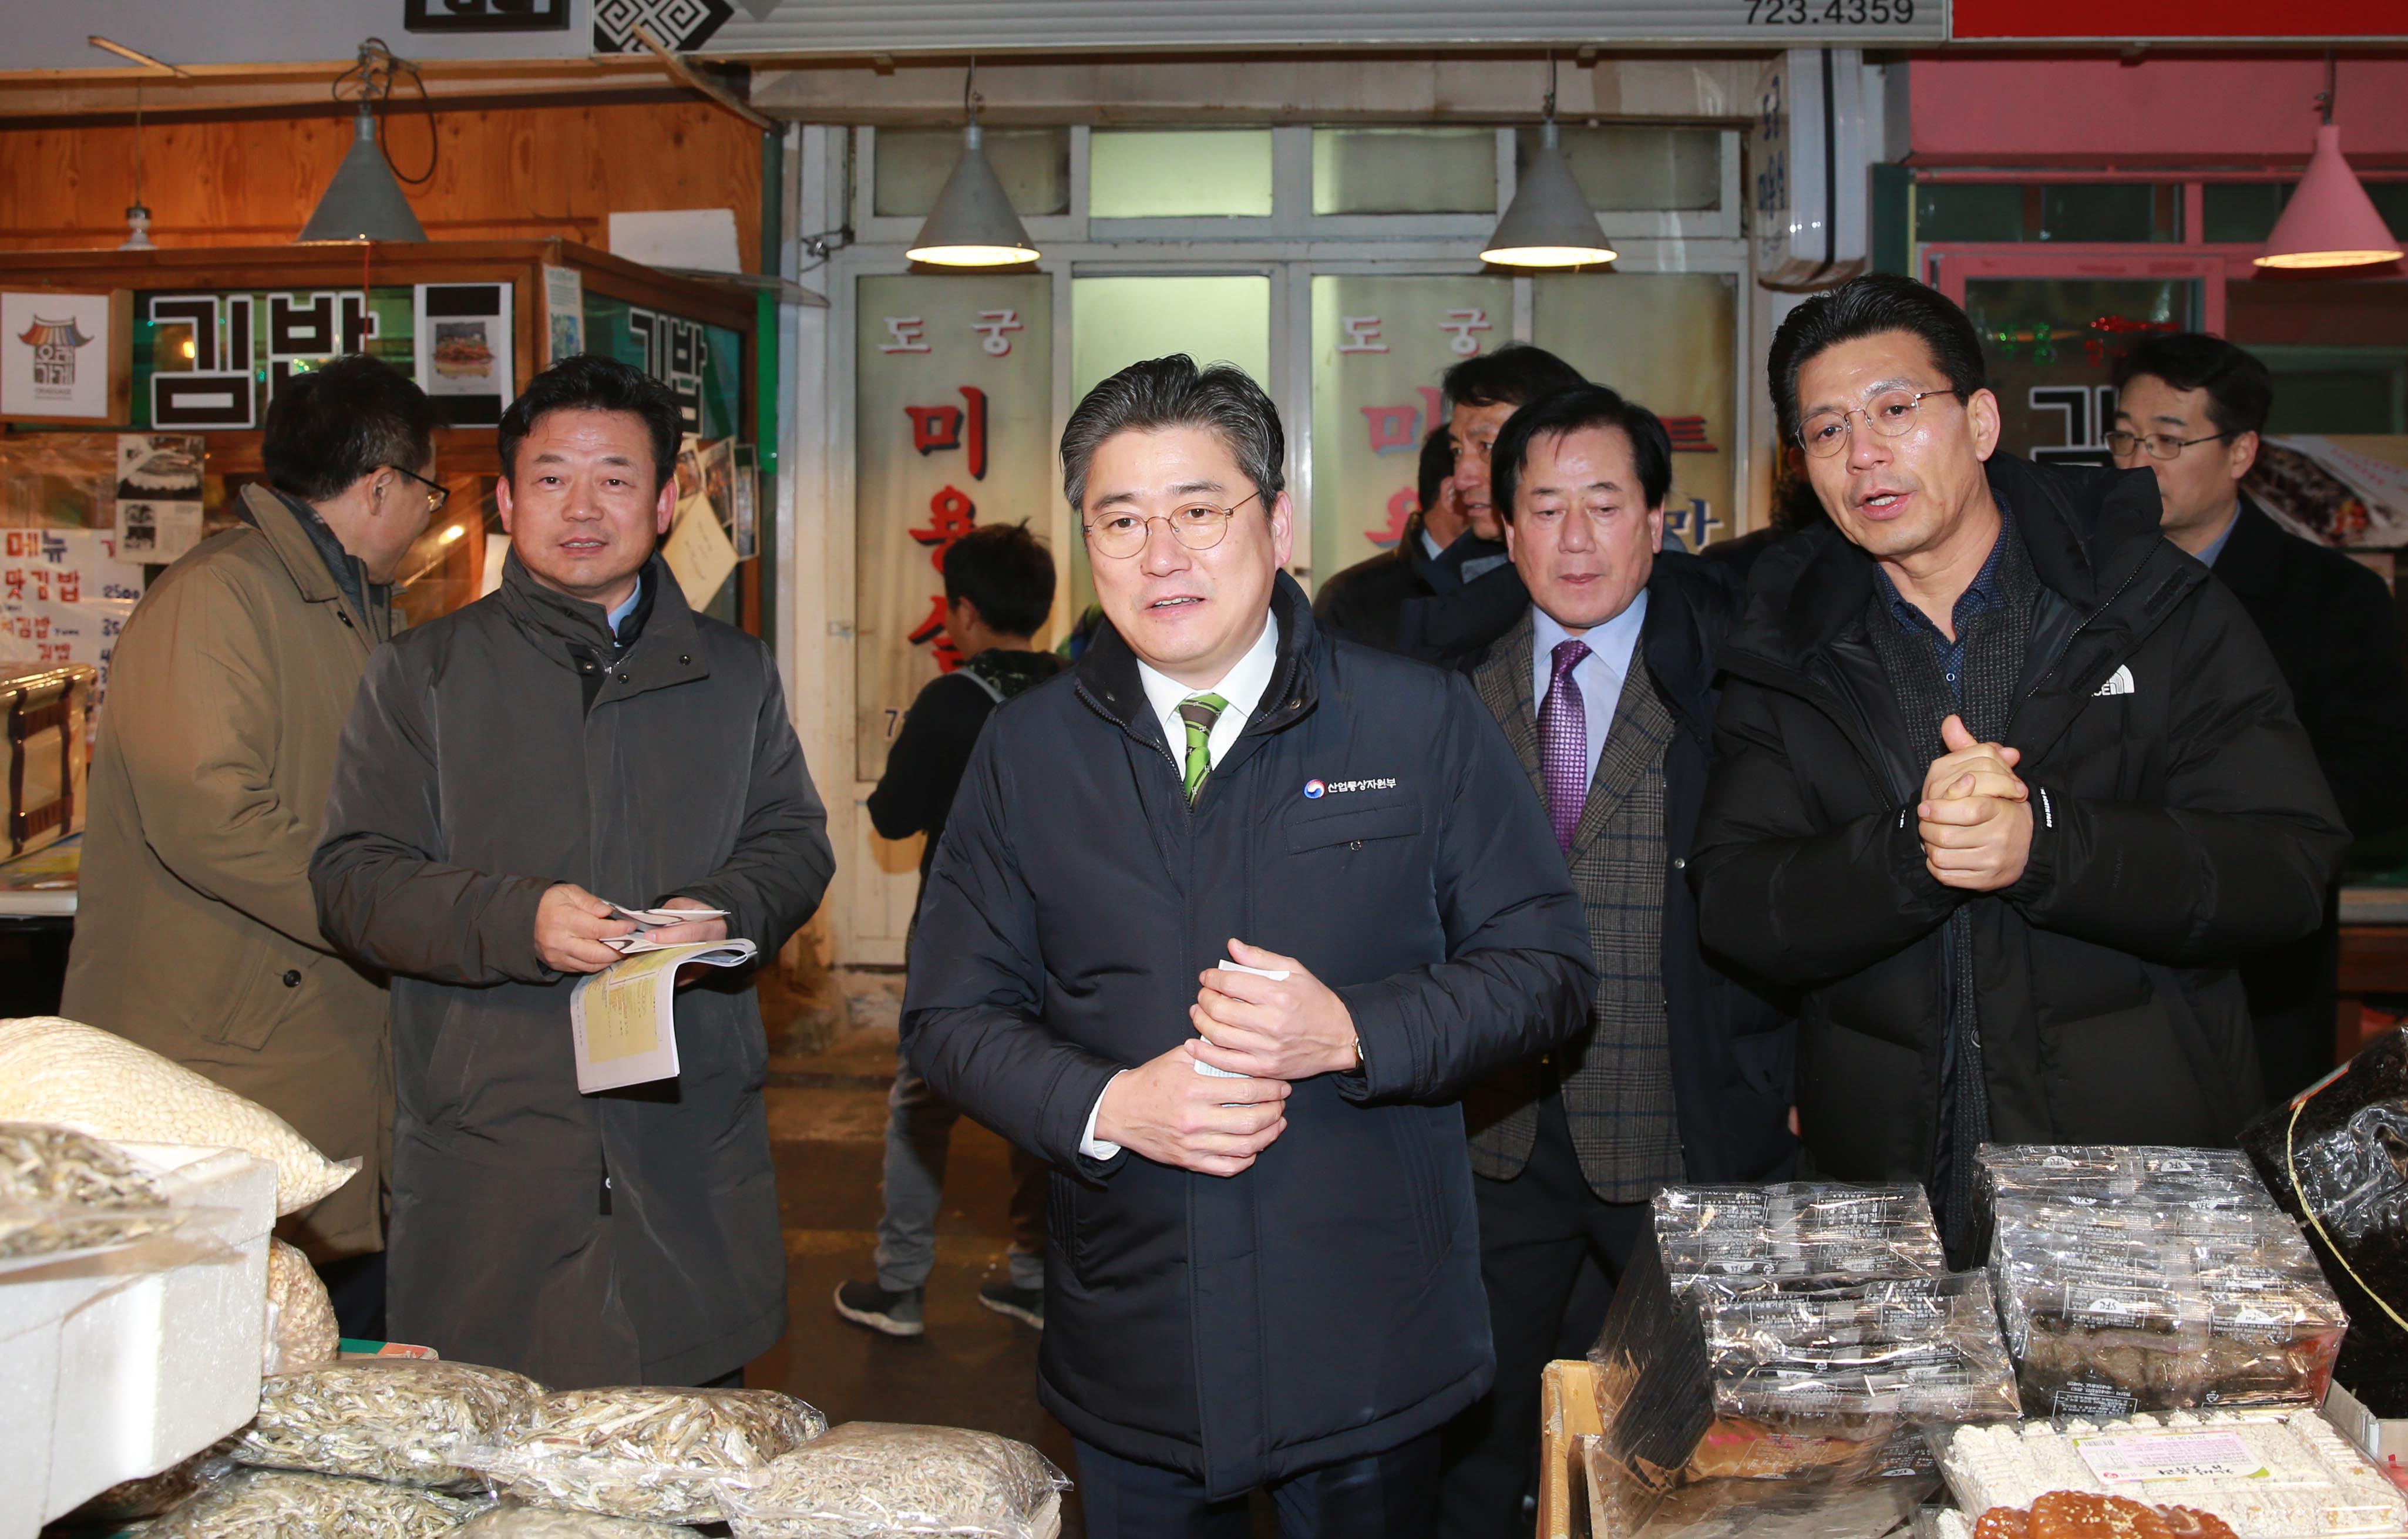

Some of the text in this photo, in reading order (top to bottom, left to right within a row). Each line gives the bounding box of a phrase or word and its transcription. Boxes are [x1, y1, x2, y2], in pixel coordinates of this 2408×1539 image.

[1744, 0, 1914, 25] 723.4359
[6, 530, 68, 563] 메뉴
[103, 584, 140, 599] 2500
[1328, 778, 1397, 793] 산업통상자원부
